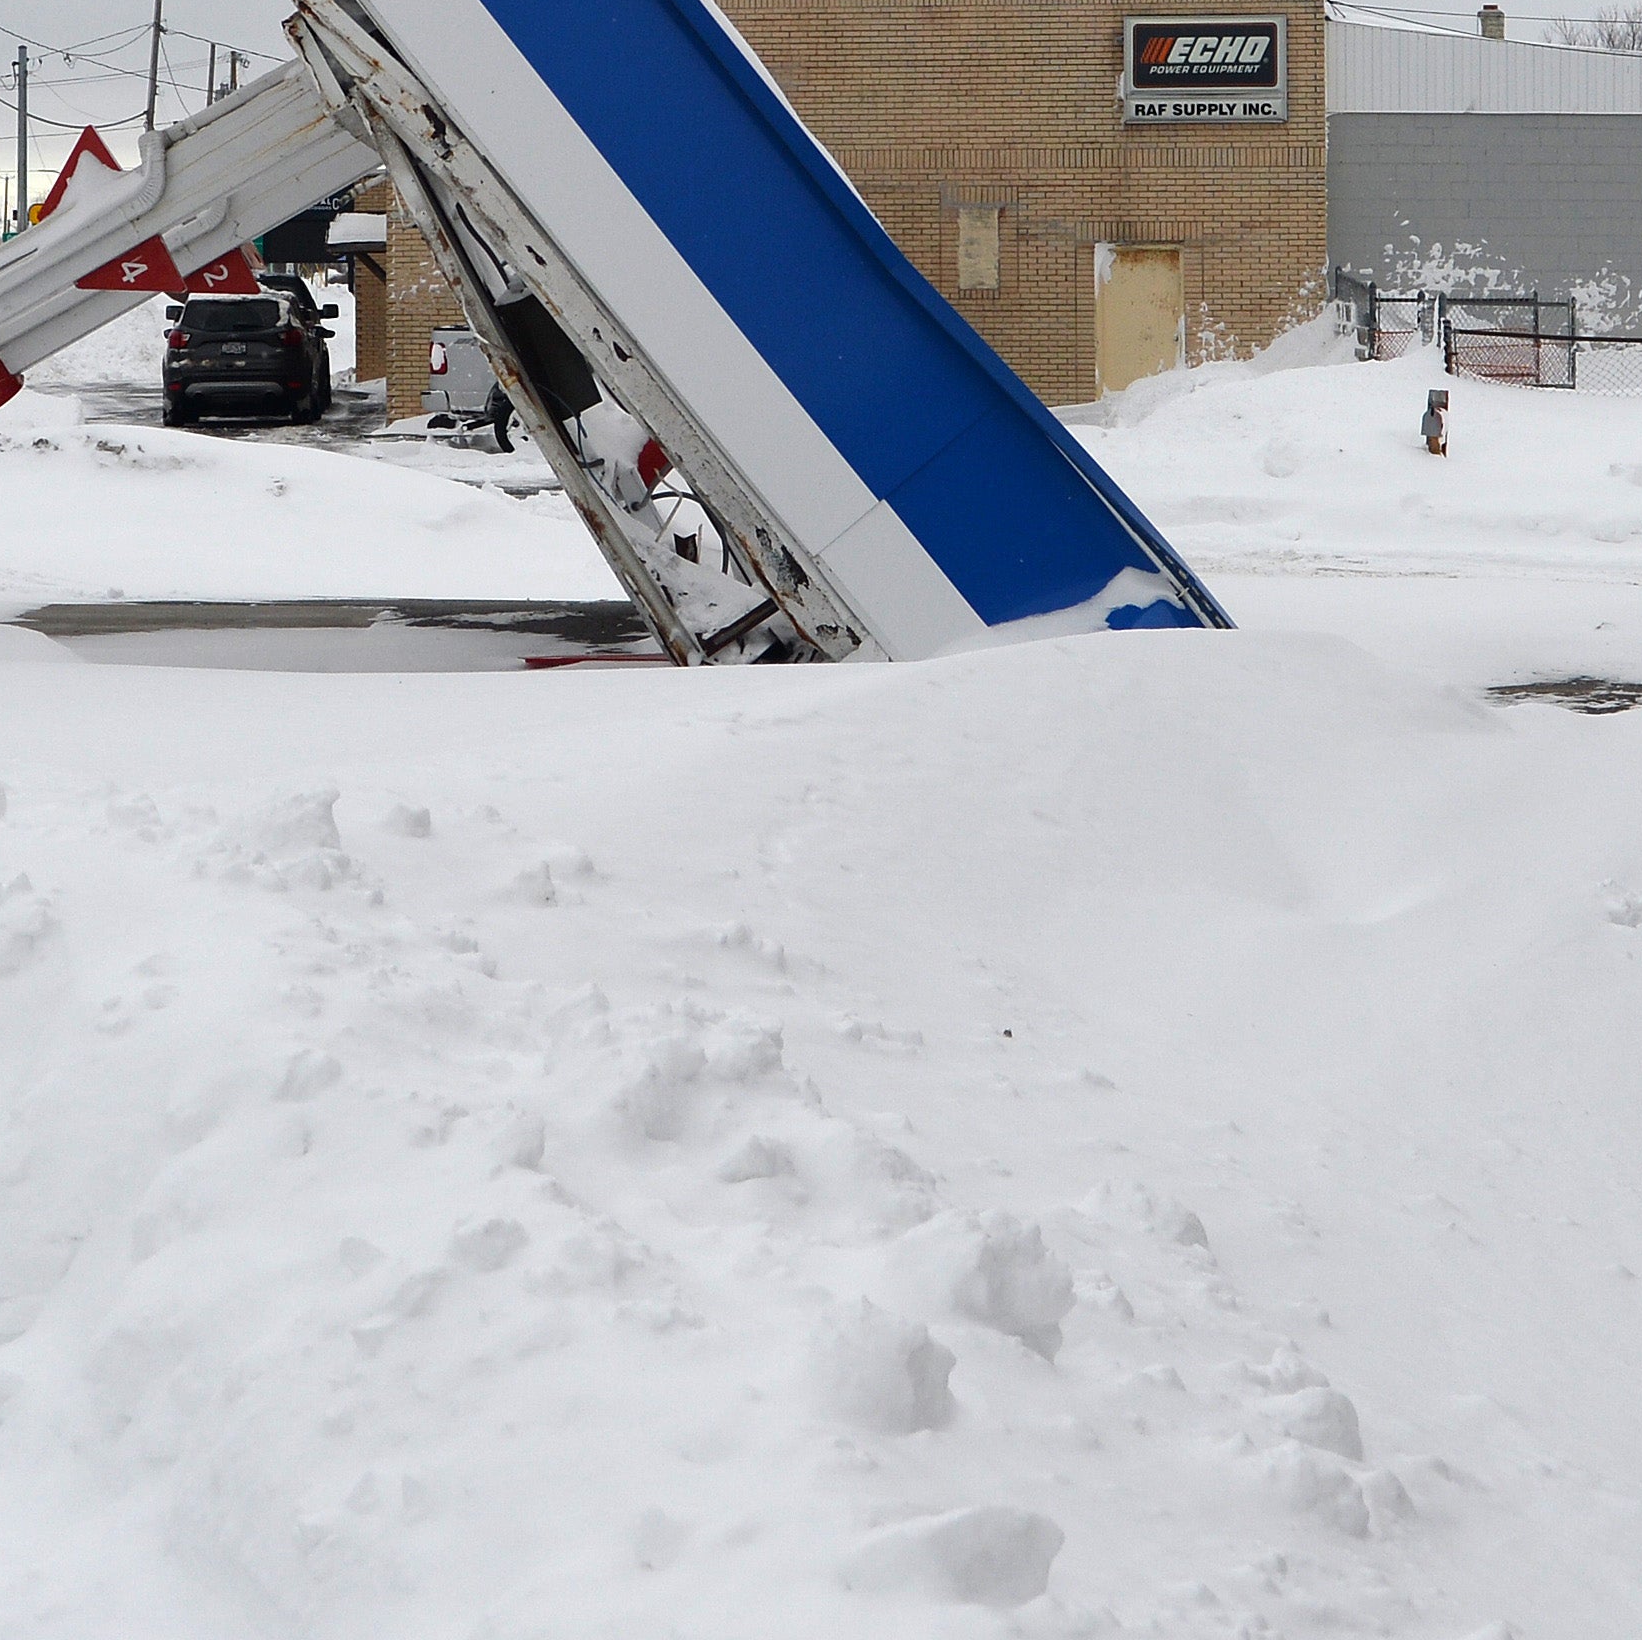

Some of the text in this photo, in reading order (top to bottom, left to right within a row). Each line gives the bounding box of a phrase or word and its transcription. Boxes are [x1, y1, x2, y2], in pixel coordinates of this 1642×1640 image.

[1167, 35, 1271, 64] ECHO
[1149, 64, 1260, 74] POWER EQUIPMENT
[1134, 103, 1278, 117] RAF SUPPLY INC.
[120, 261, 149, 284] 4
[203, 263, 229, 288] 2
